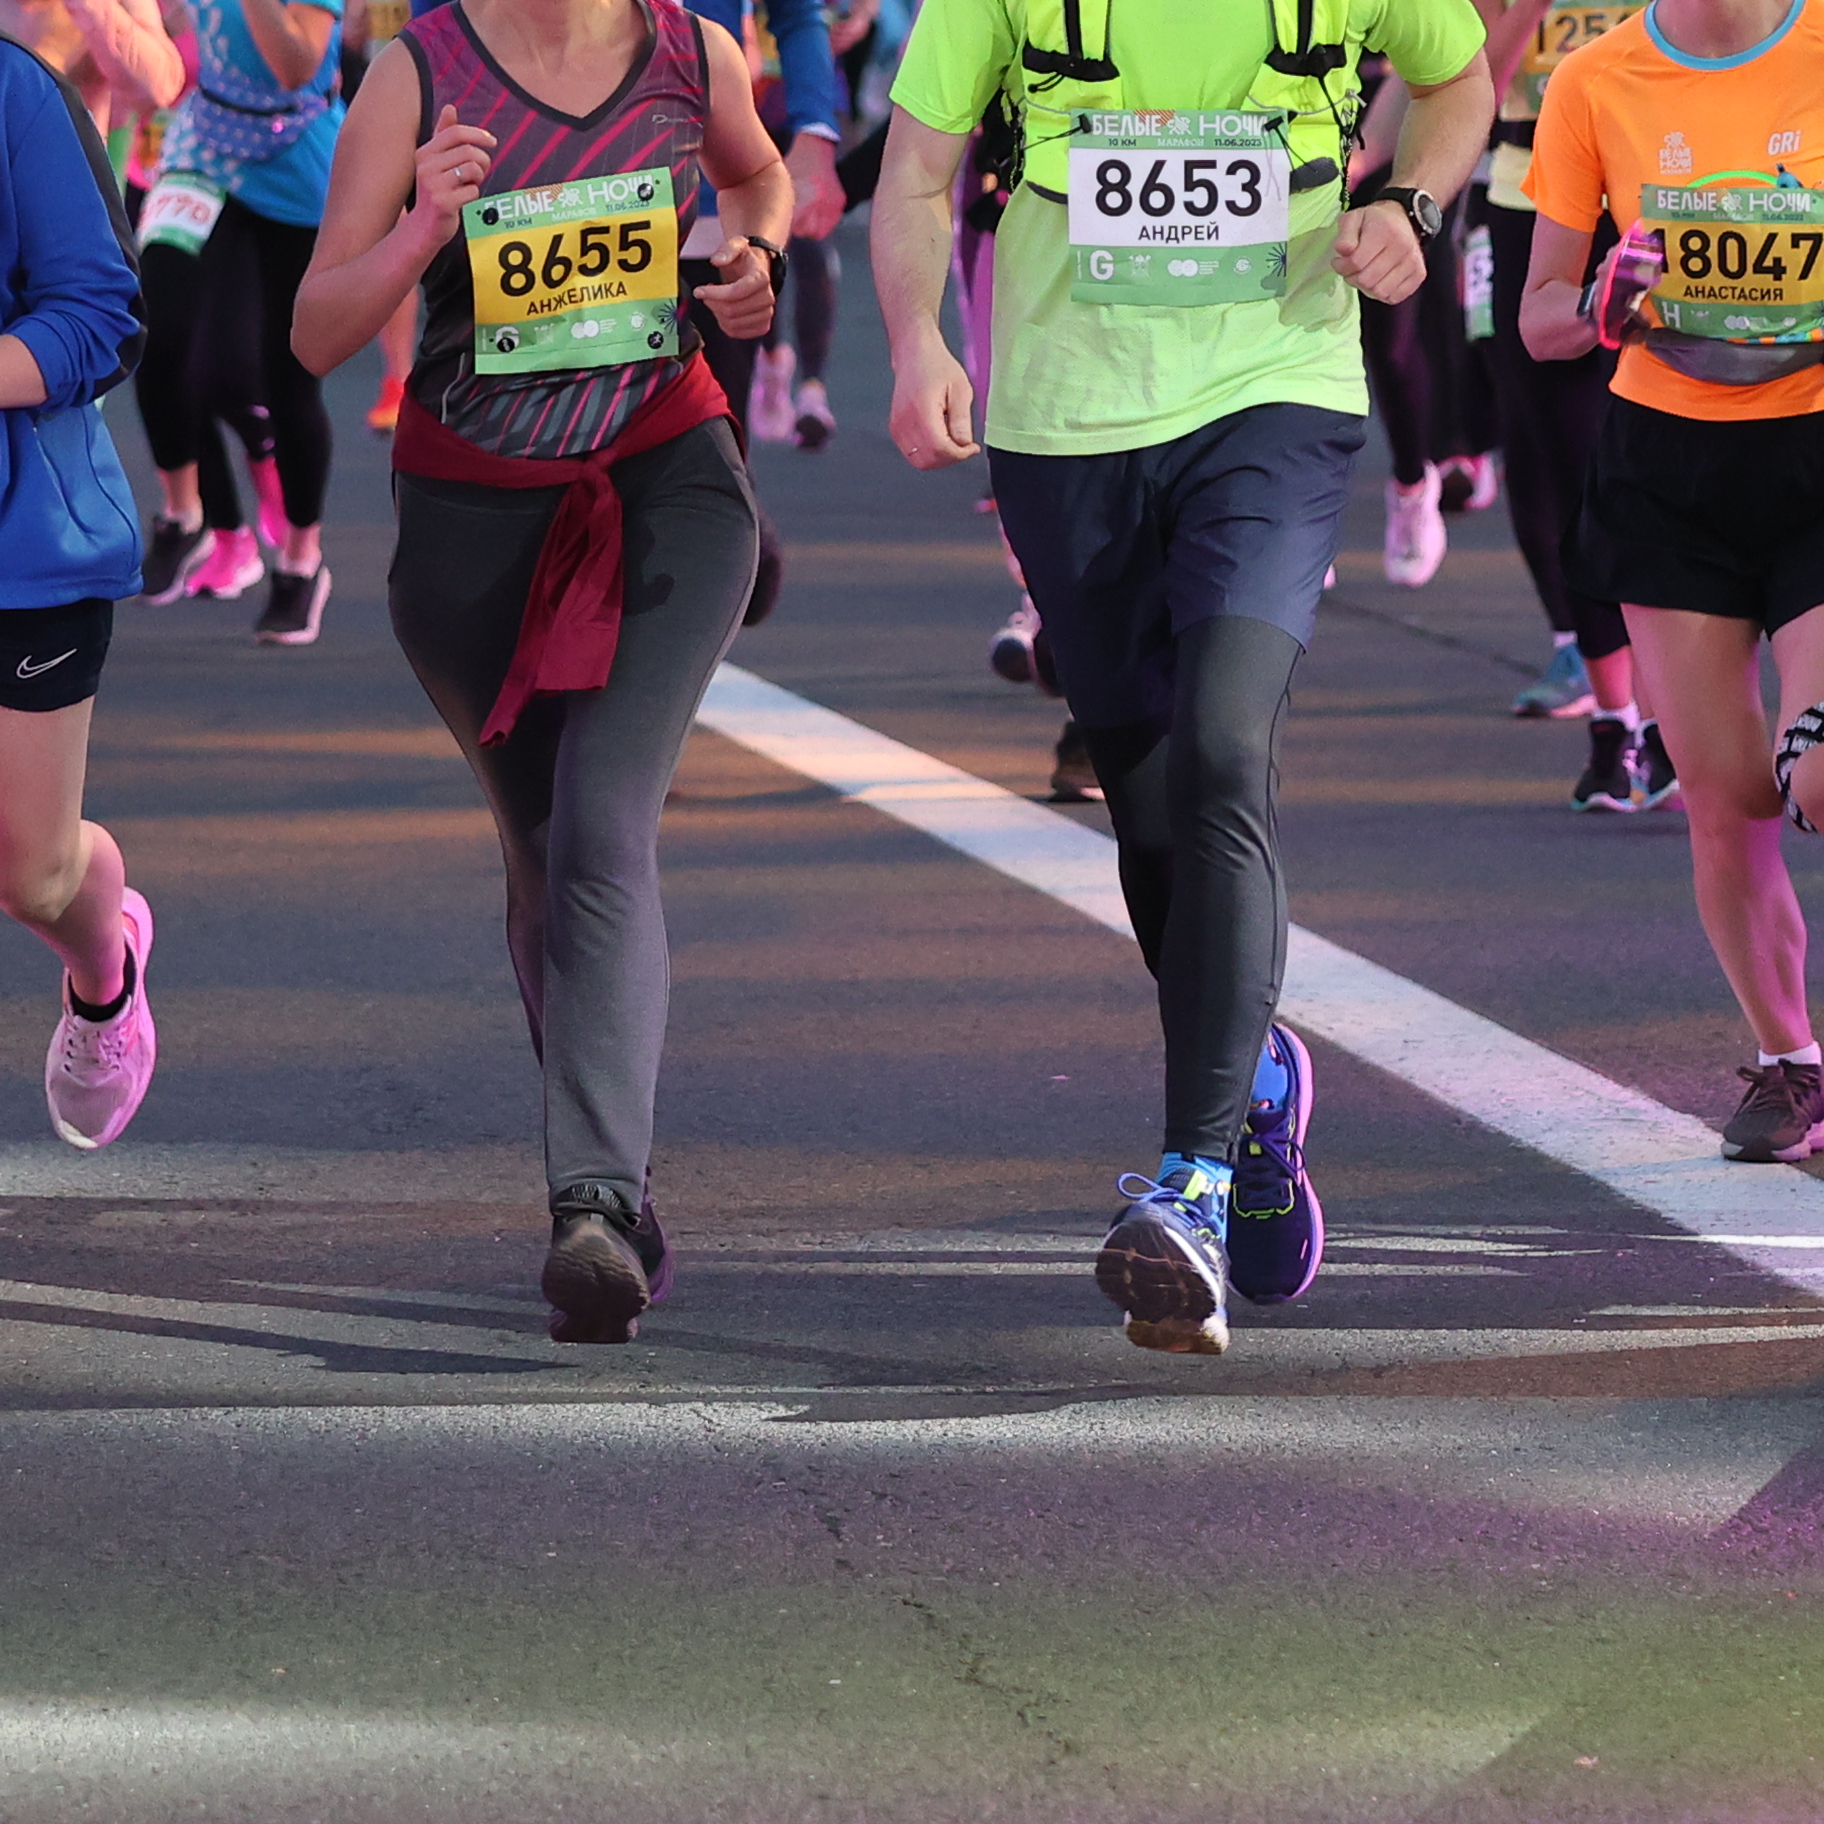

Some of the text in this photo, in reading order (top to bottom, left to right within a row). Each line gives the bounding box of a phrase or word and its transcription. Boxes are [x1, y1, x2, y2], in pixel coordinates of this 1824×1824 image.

[1091, 114, 1270, 137] БЕЛЫЕ НОЧИ
[1214, 138, 1263, 147] 11.06.2023
[1095, 159, 1263, 217] 8653
[1656, 189, 1811, 212] БЕЛЫЕ НОЧИ
[1138, 221, 1220, 244] АНДРЕЙ
[498, 219, 653, 297] 8655
[1089, 249, 1115, 281] G
[526, 281, 629, 316] АНЖЕЛИКА
[1683, 284, 1784, 301] АНАСТАСИЯ
